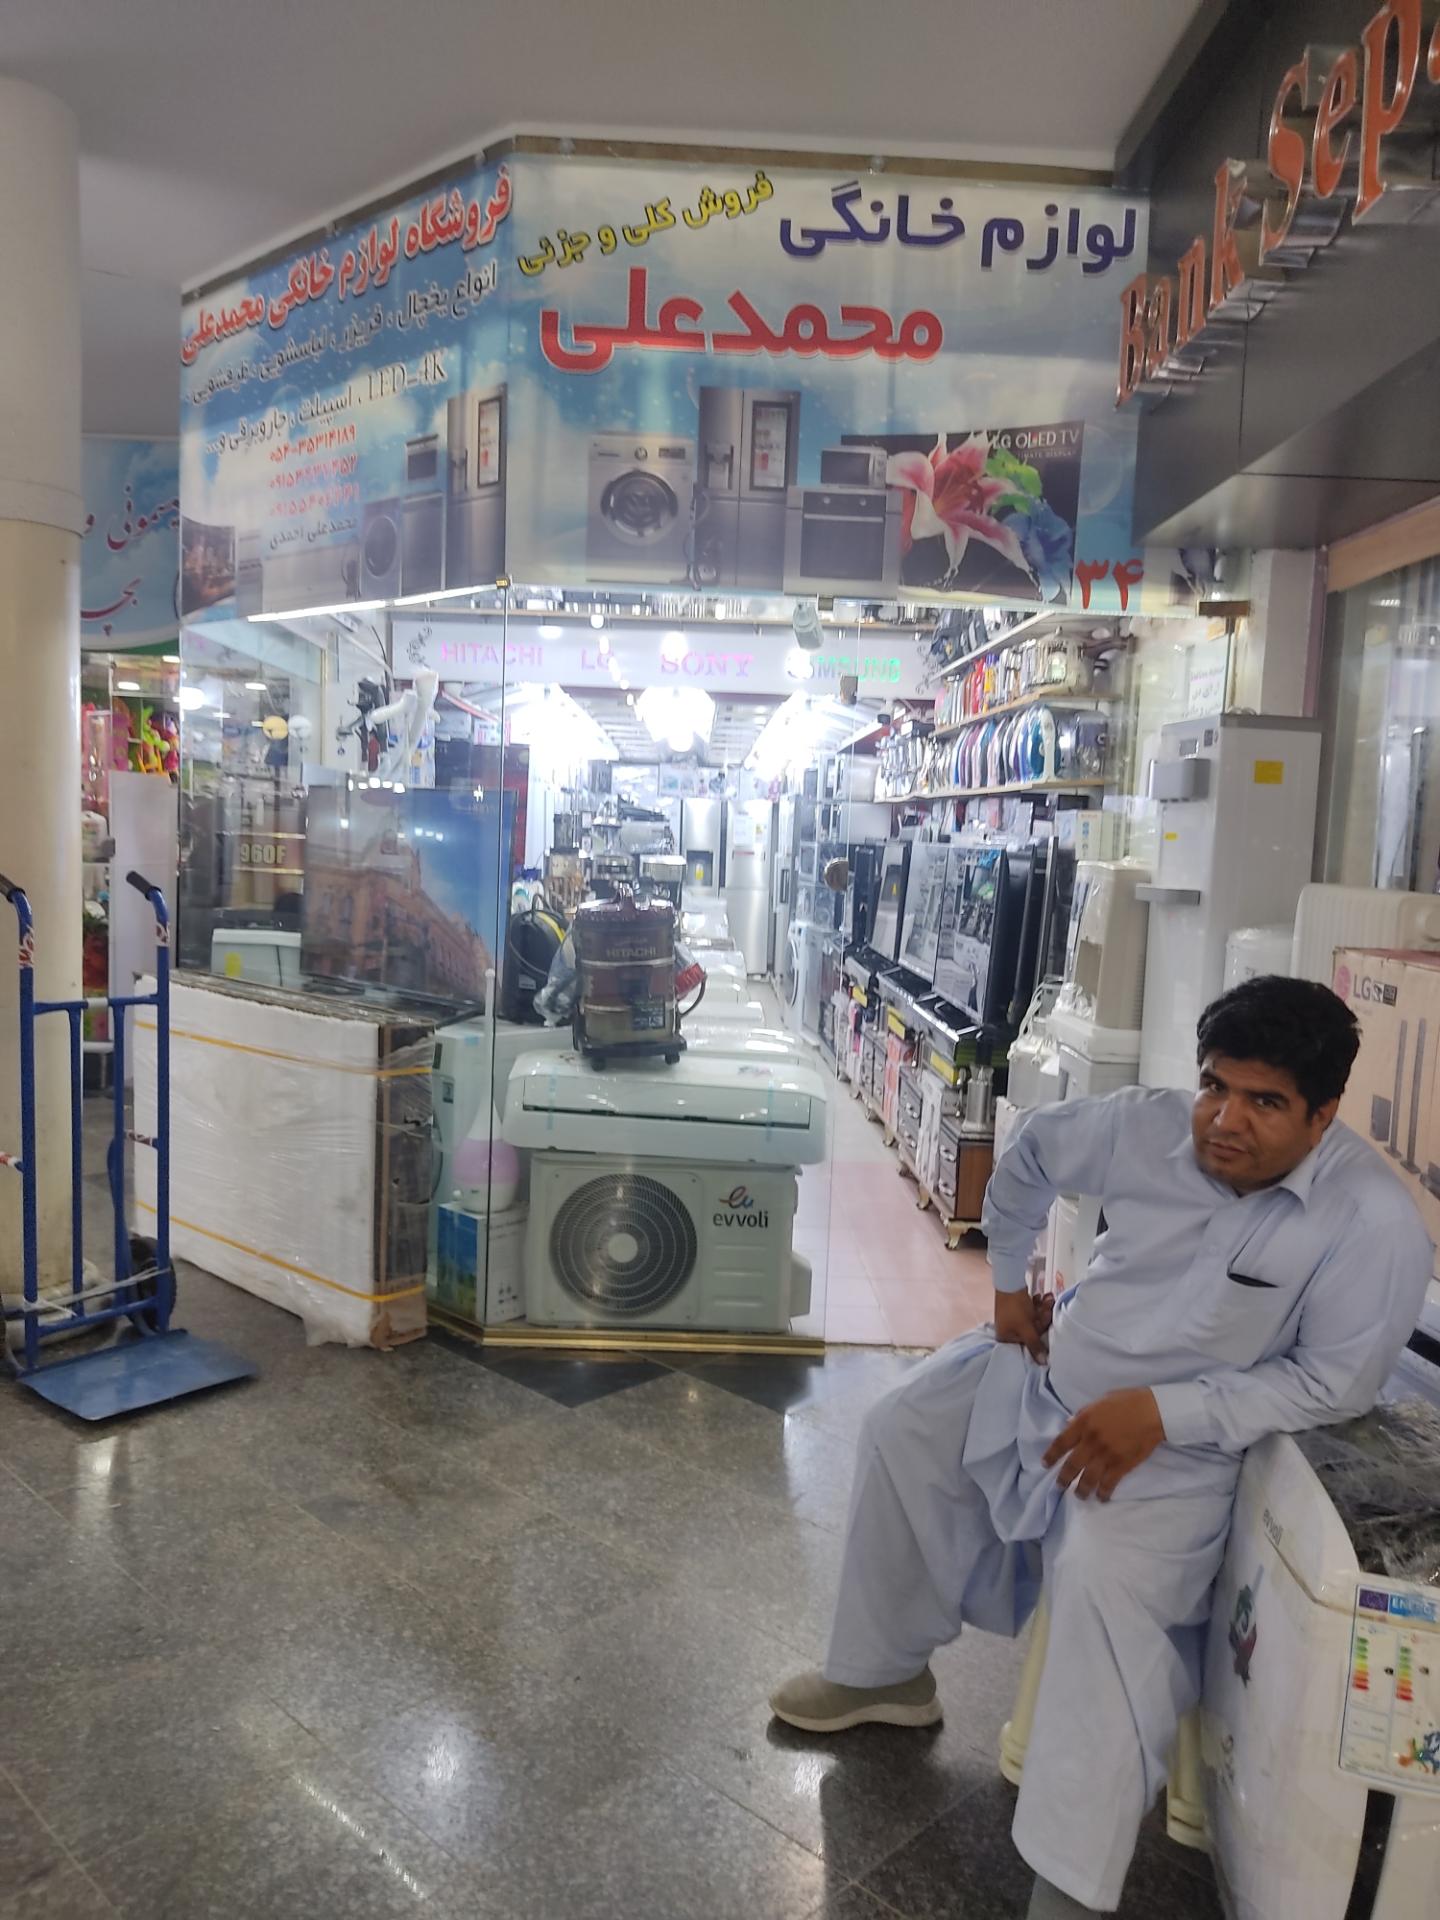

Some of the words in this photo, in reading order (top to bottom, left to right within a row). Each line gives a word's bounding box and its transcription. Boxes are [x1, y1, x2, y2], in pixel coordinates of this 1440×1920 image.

[405, 163, 513, 260] فروشگاه
[621, 197, 676, 246] کلی
[682, 171, 775, 229] فروش
[779, 180, 967, 257] خانگی
[1113, 158, 1247, 412] Bank
[1259, 0, 1440, 265] Sep
[338, 215, 400, 301] لوازم
[598, 226, 617, 256] و
[980, 203, 1137, 275] لوازم
[539, 265, 944, 373] محمدعلی
[1015, 430, 1057, 449] OLED
[1060, 427, 1080, 445] TV
[1074, 559, 1145, 612] ۳۴
[440, 639, 544, 667] HITACHI
[660, 650, 754, 678] SONY
[1353, 973, 1372, 1001] LG
[712, 1208, 769, 1229] evvoli
